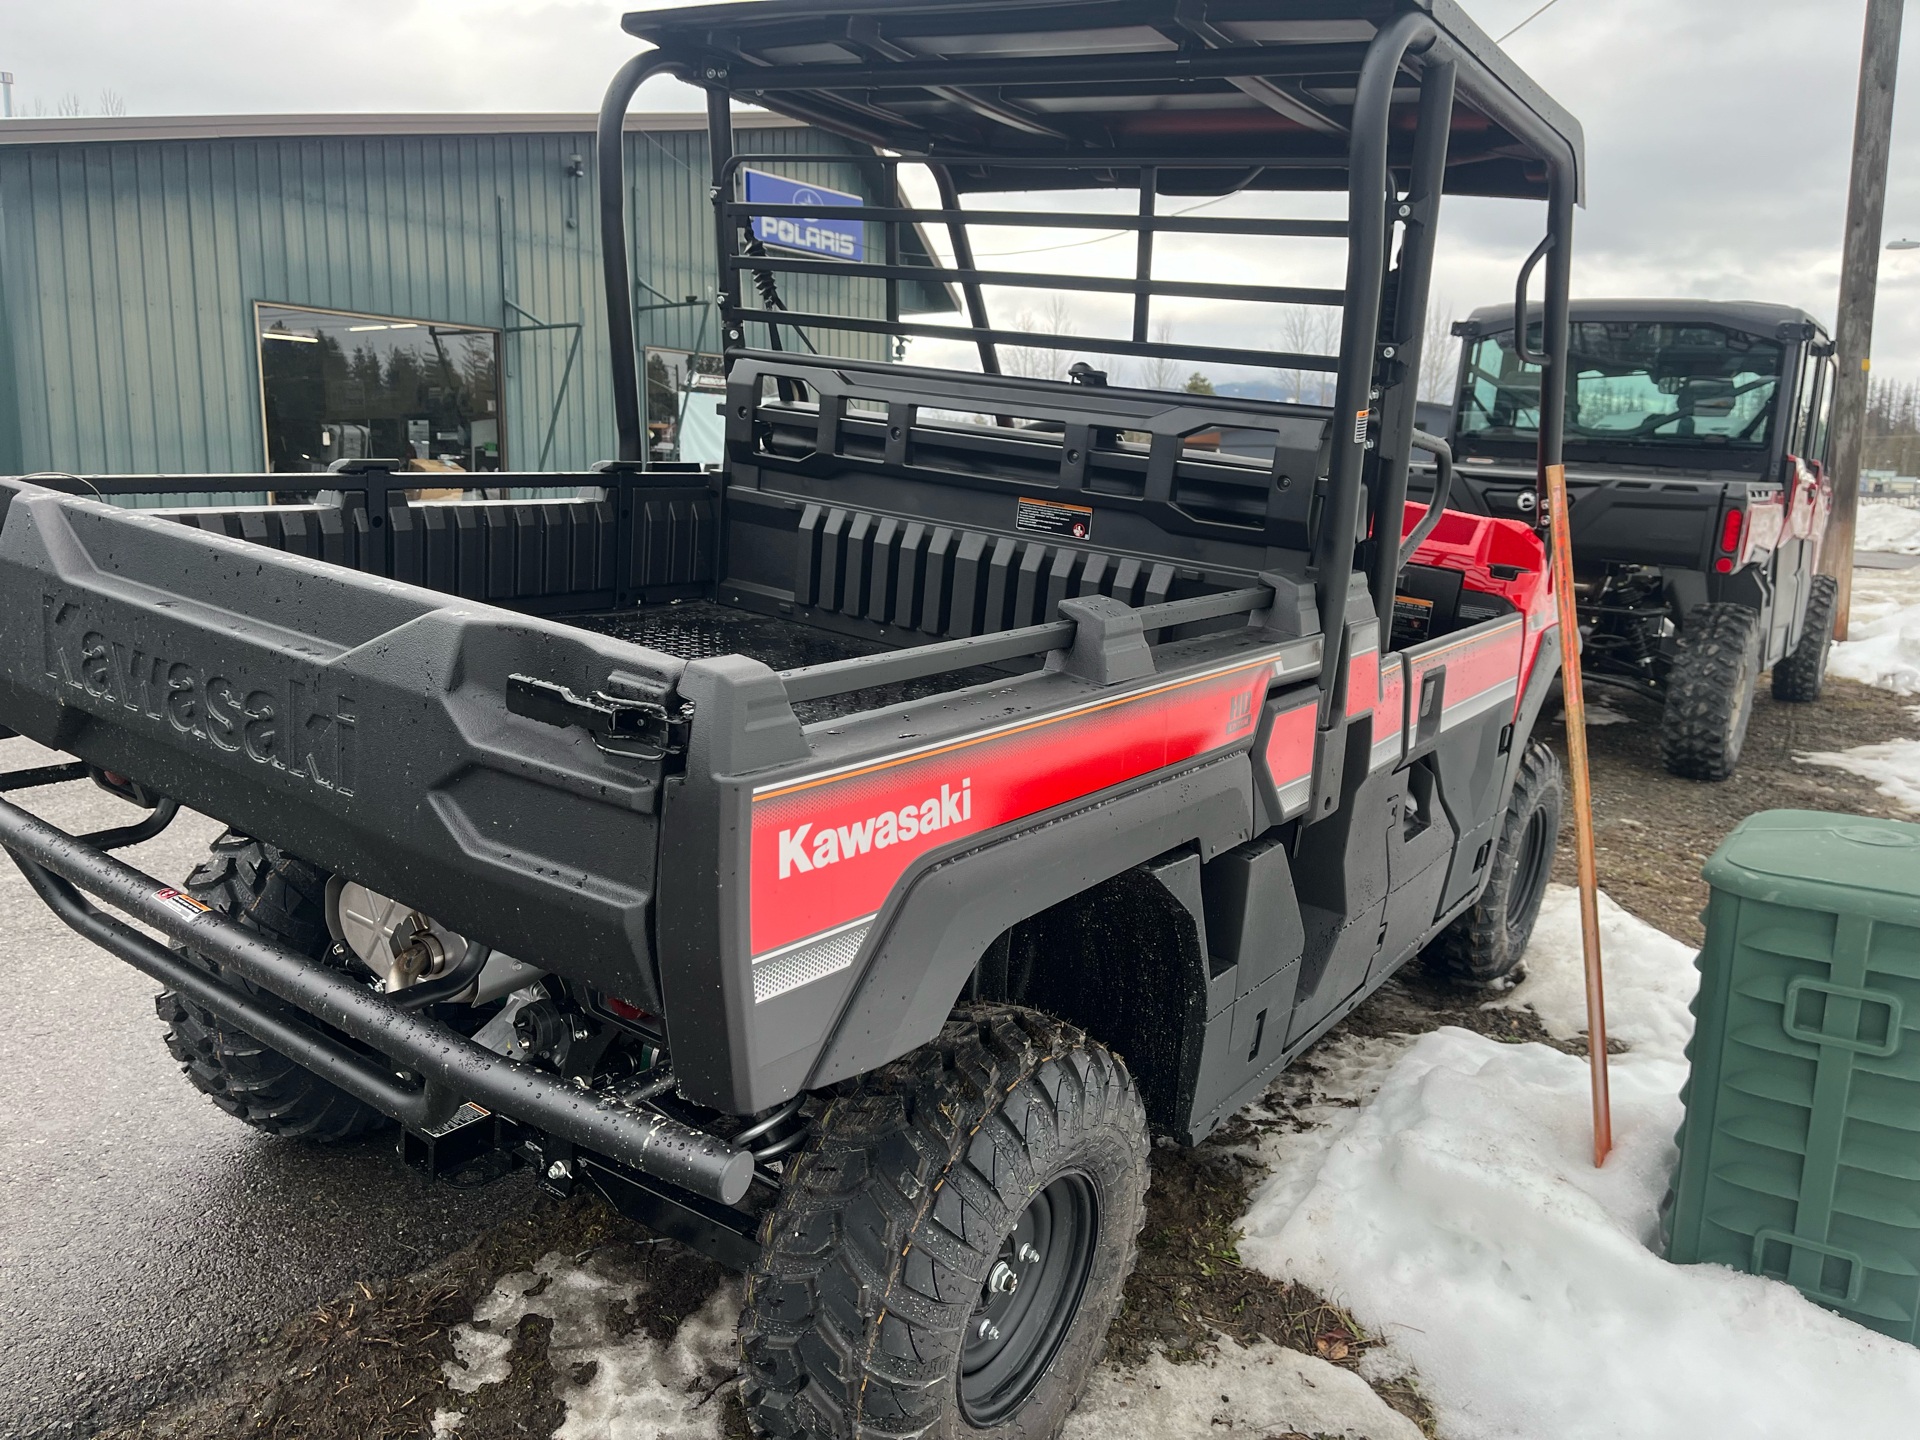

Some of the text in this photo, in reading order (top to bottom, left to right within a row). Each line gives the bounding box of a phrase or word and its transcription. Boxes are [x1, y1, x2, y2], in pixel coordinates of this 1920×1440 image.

[760, 216, 855, 256] POLARIS
[42, 594, 356, 797] Kawasaki
[1229, 690, 1252, 721] HD
[778, 778, 972, 880] Kawasaki
